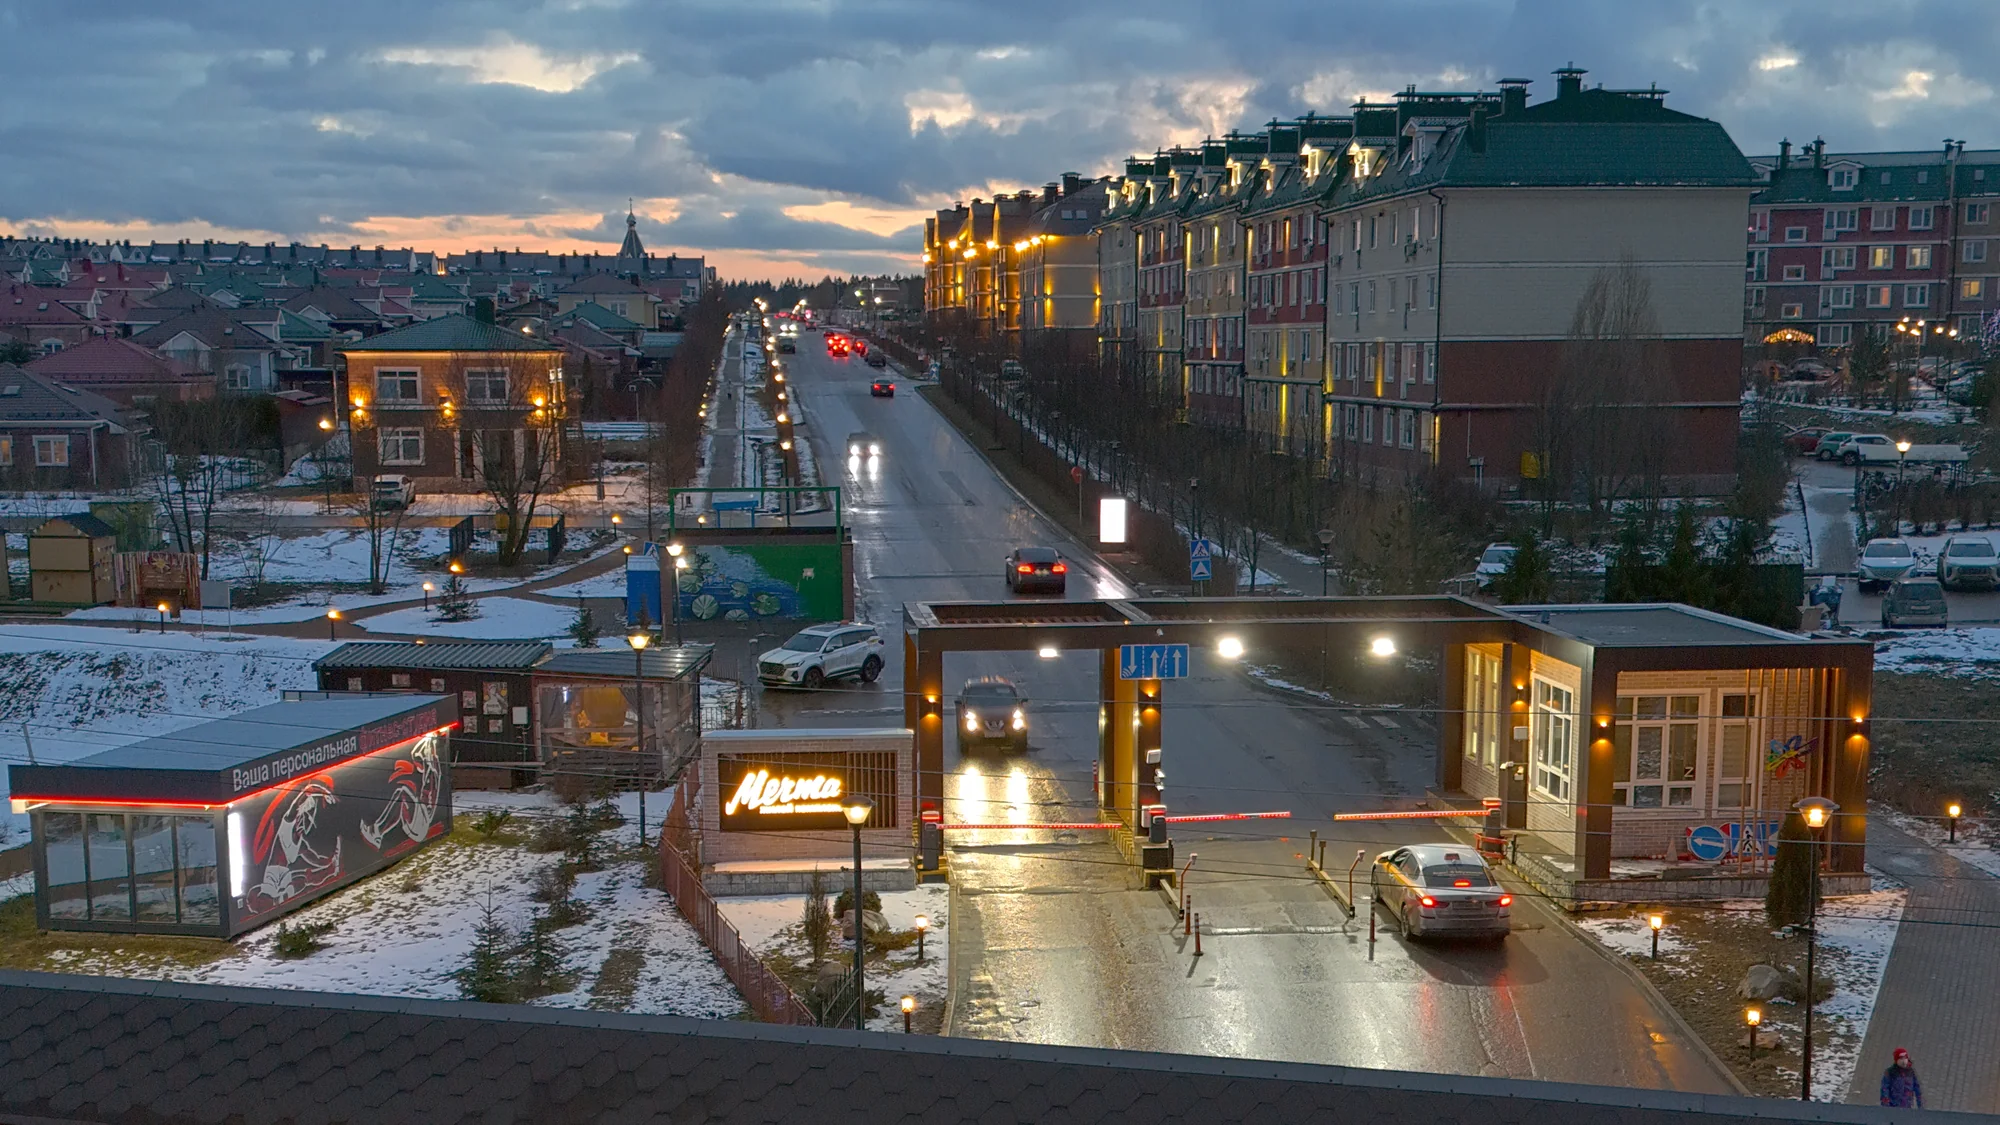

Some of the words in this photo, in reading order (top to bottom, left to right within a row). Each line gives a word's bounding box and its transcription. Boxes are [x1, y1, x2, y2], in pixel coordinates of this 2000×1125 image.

[232, 763, 269, 792] Ваша
[272, 736, 357, 779] персональная
[725, 769, 841, 815] Мечта
